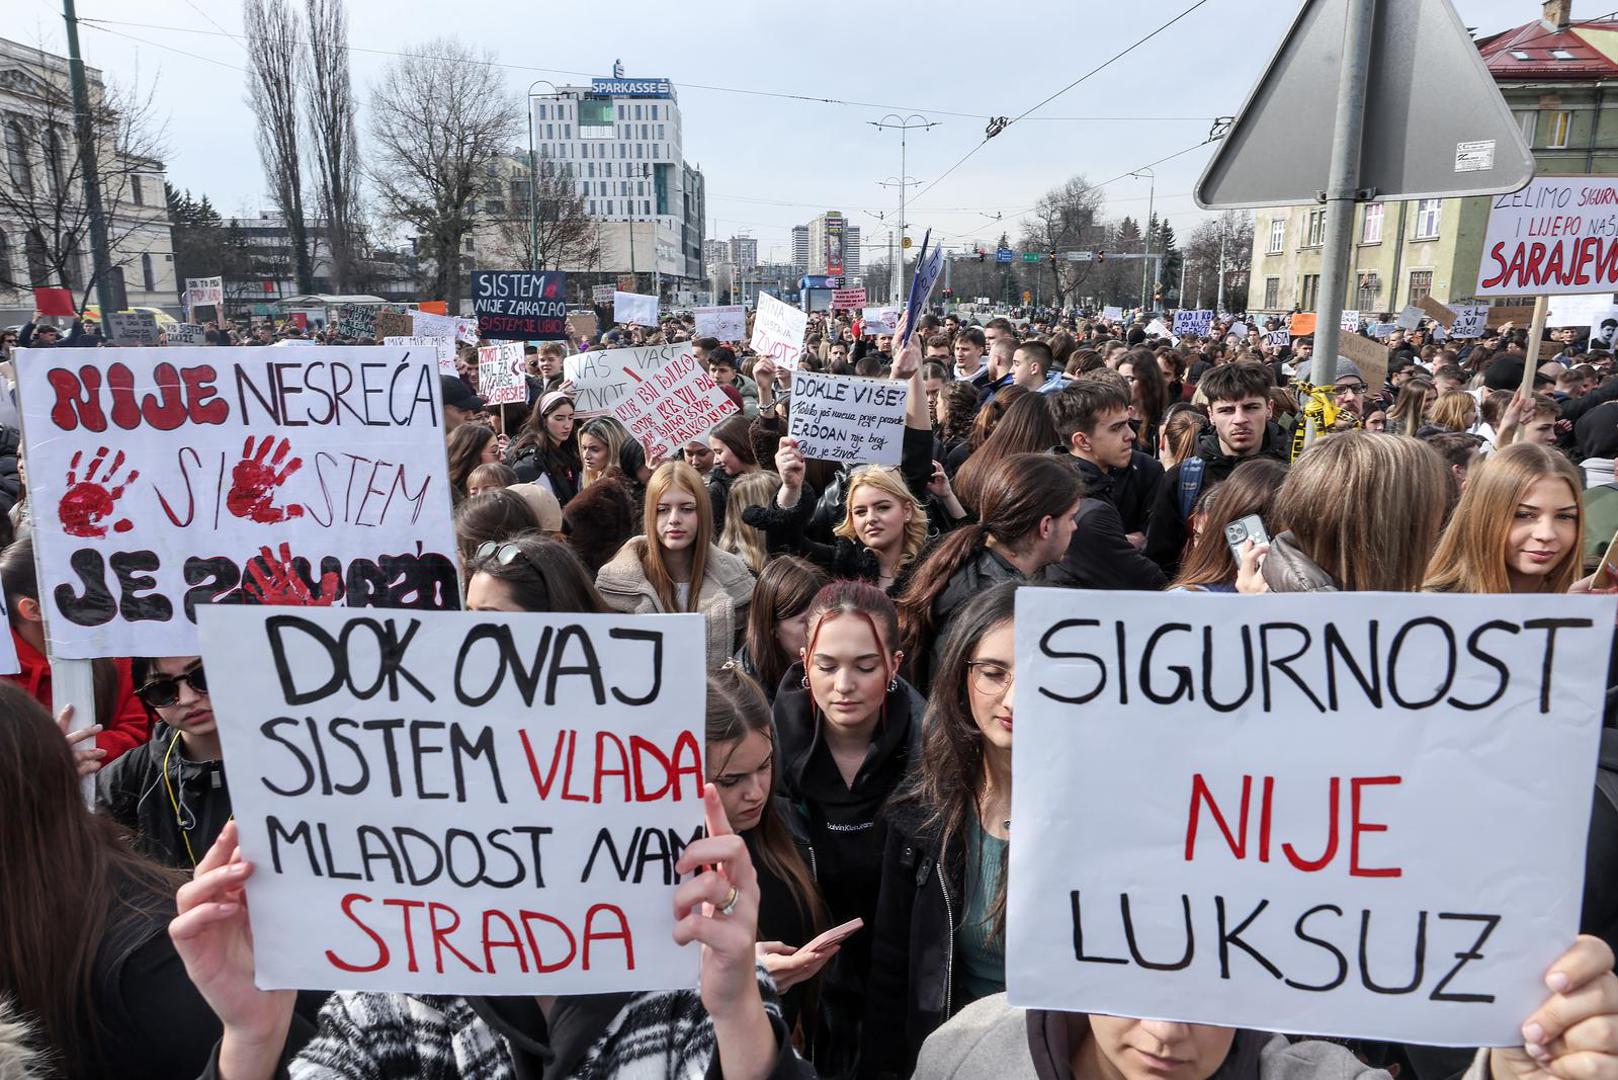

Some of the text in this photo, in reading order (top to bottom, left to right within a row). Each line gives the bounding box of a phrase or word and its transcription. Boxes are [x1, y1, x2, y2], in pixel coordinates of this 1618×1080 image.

[592, 82, 657, 94] SPARKASSE
[1516, 214, 1618, 238] I LIJEPO NAŠ
[475, 299, 566, 317] NIJE ZAKAZAO
[479, 273, 545, 298] SISTEM
[480, 316, 523, 331] SISTEM
[47, 352, 438, 433] NIJE NESREĆA
[615, 398, 641, 422] NE
[795, 377, 907, 407] DOKLE VIŠE?
[791, 418, 848, 442] ERDOAN
[54, 548, 173, 627] JE
[265, 614, 664, 708] DOK OVAJ
[1038, 616, 1594, 713] SIGURNOST
[260, 717, 705, 804] SISTEM VLADA
[265, 815, 704, 888] MLADOST NAM
[1184, 772, 1403, 878] NIJE
[325, 893, 635, 975] STRADA
[1070, 890, 1503, 1004] LUKSUZ
